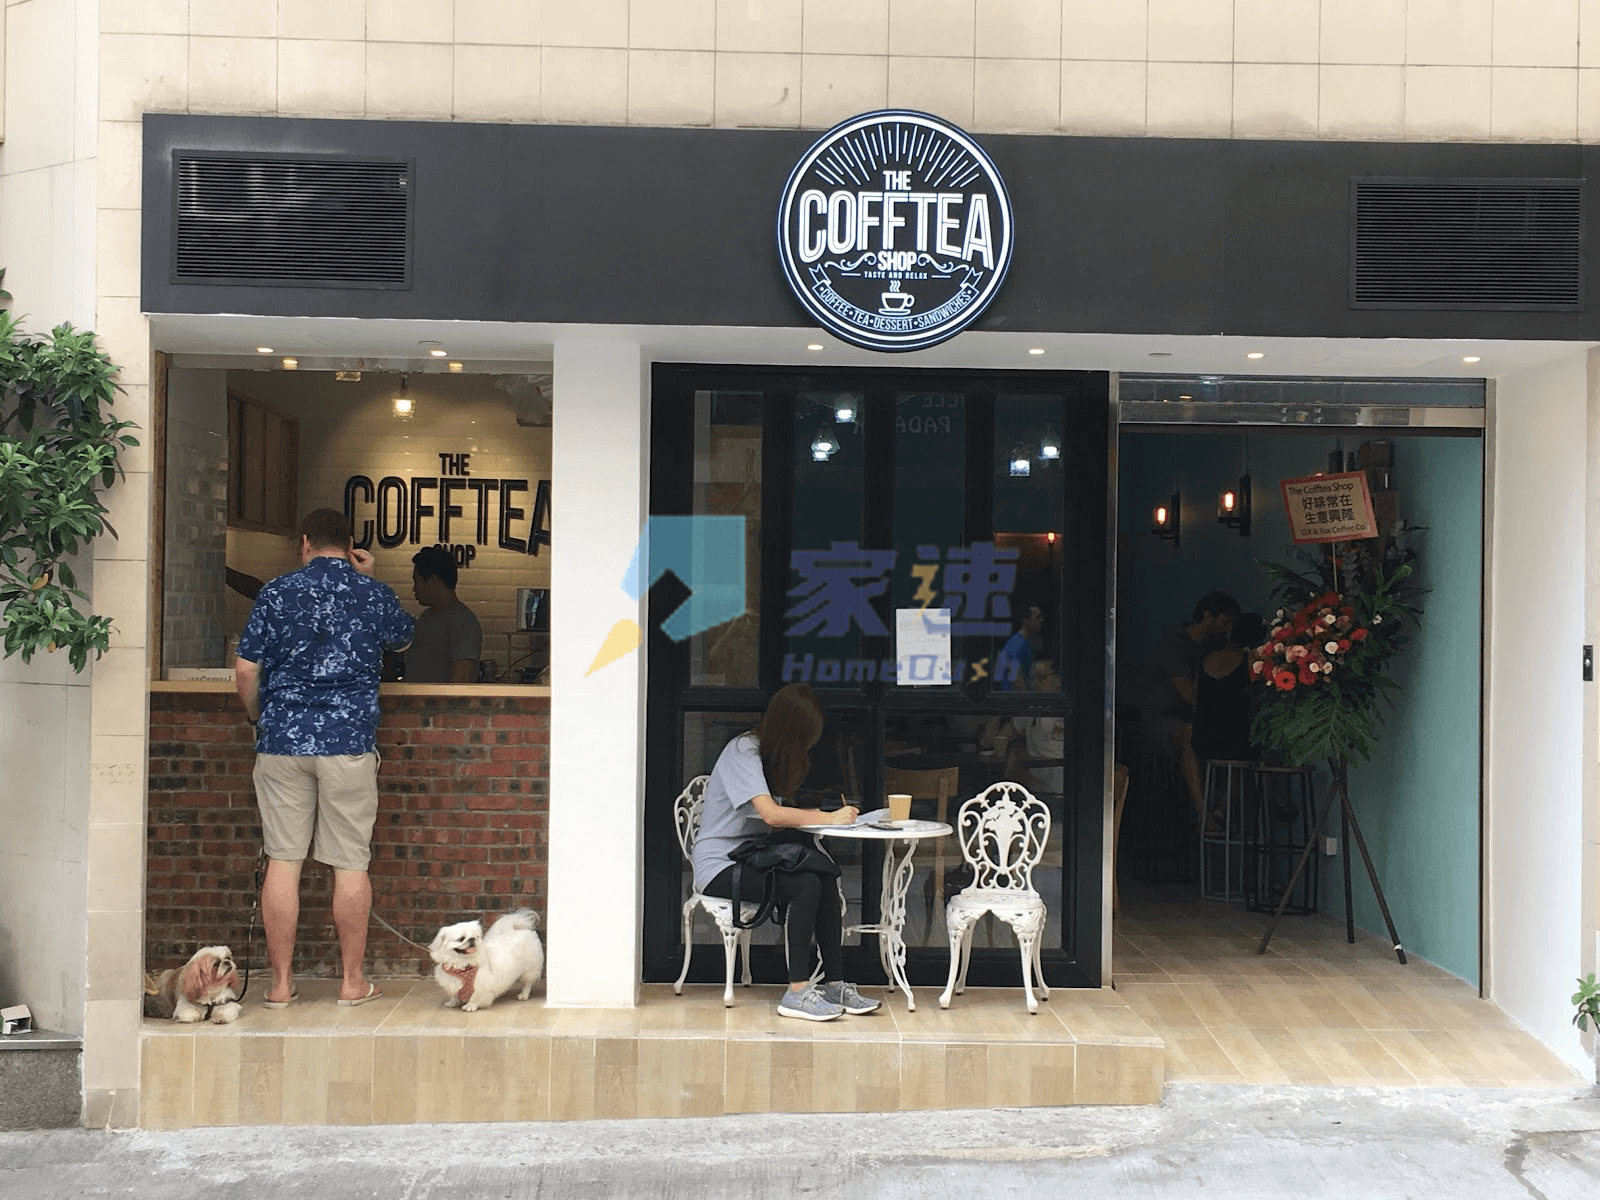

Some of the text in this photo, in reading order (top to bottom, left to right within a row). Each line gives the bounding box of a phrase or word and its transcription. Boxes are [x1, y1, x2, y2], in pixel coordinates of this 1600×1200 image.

[883, 170, 912, 190] THE
[799, 189, 994, 270] COFFTEA
[877, 251, 917, 271] SHOP
[864, 271, 928, 280] TASTE AND RELAX
[820, 288, 971, 331] COFFEE TEA DESSERT SANDWICHES
[438, 453, 470, 476] THE
[1288, 487, 1302, 495] The
[1332, 482, 1354, 491] Shop
[1305, 508, 1355, 524] 生意興隆
[1332, 525, 1354, 534] Coffee
[433, 543, 476, 569] OP
